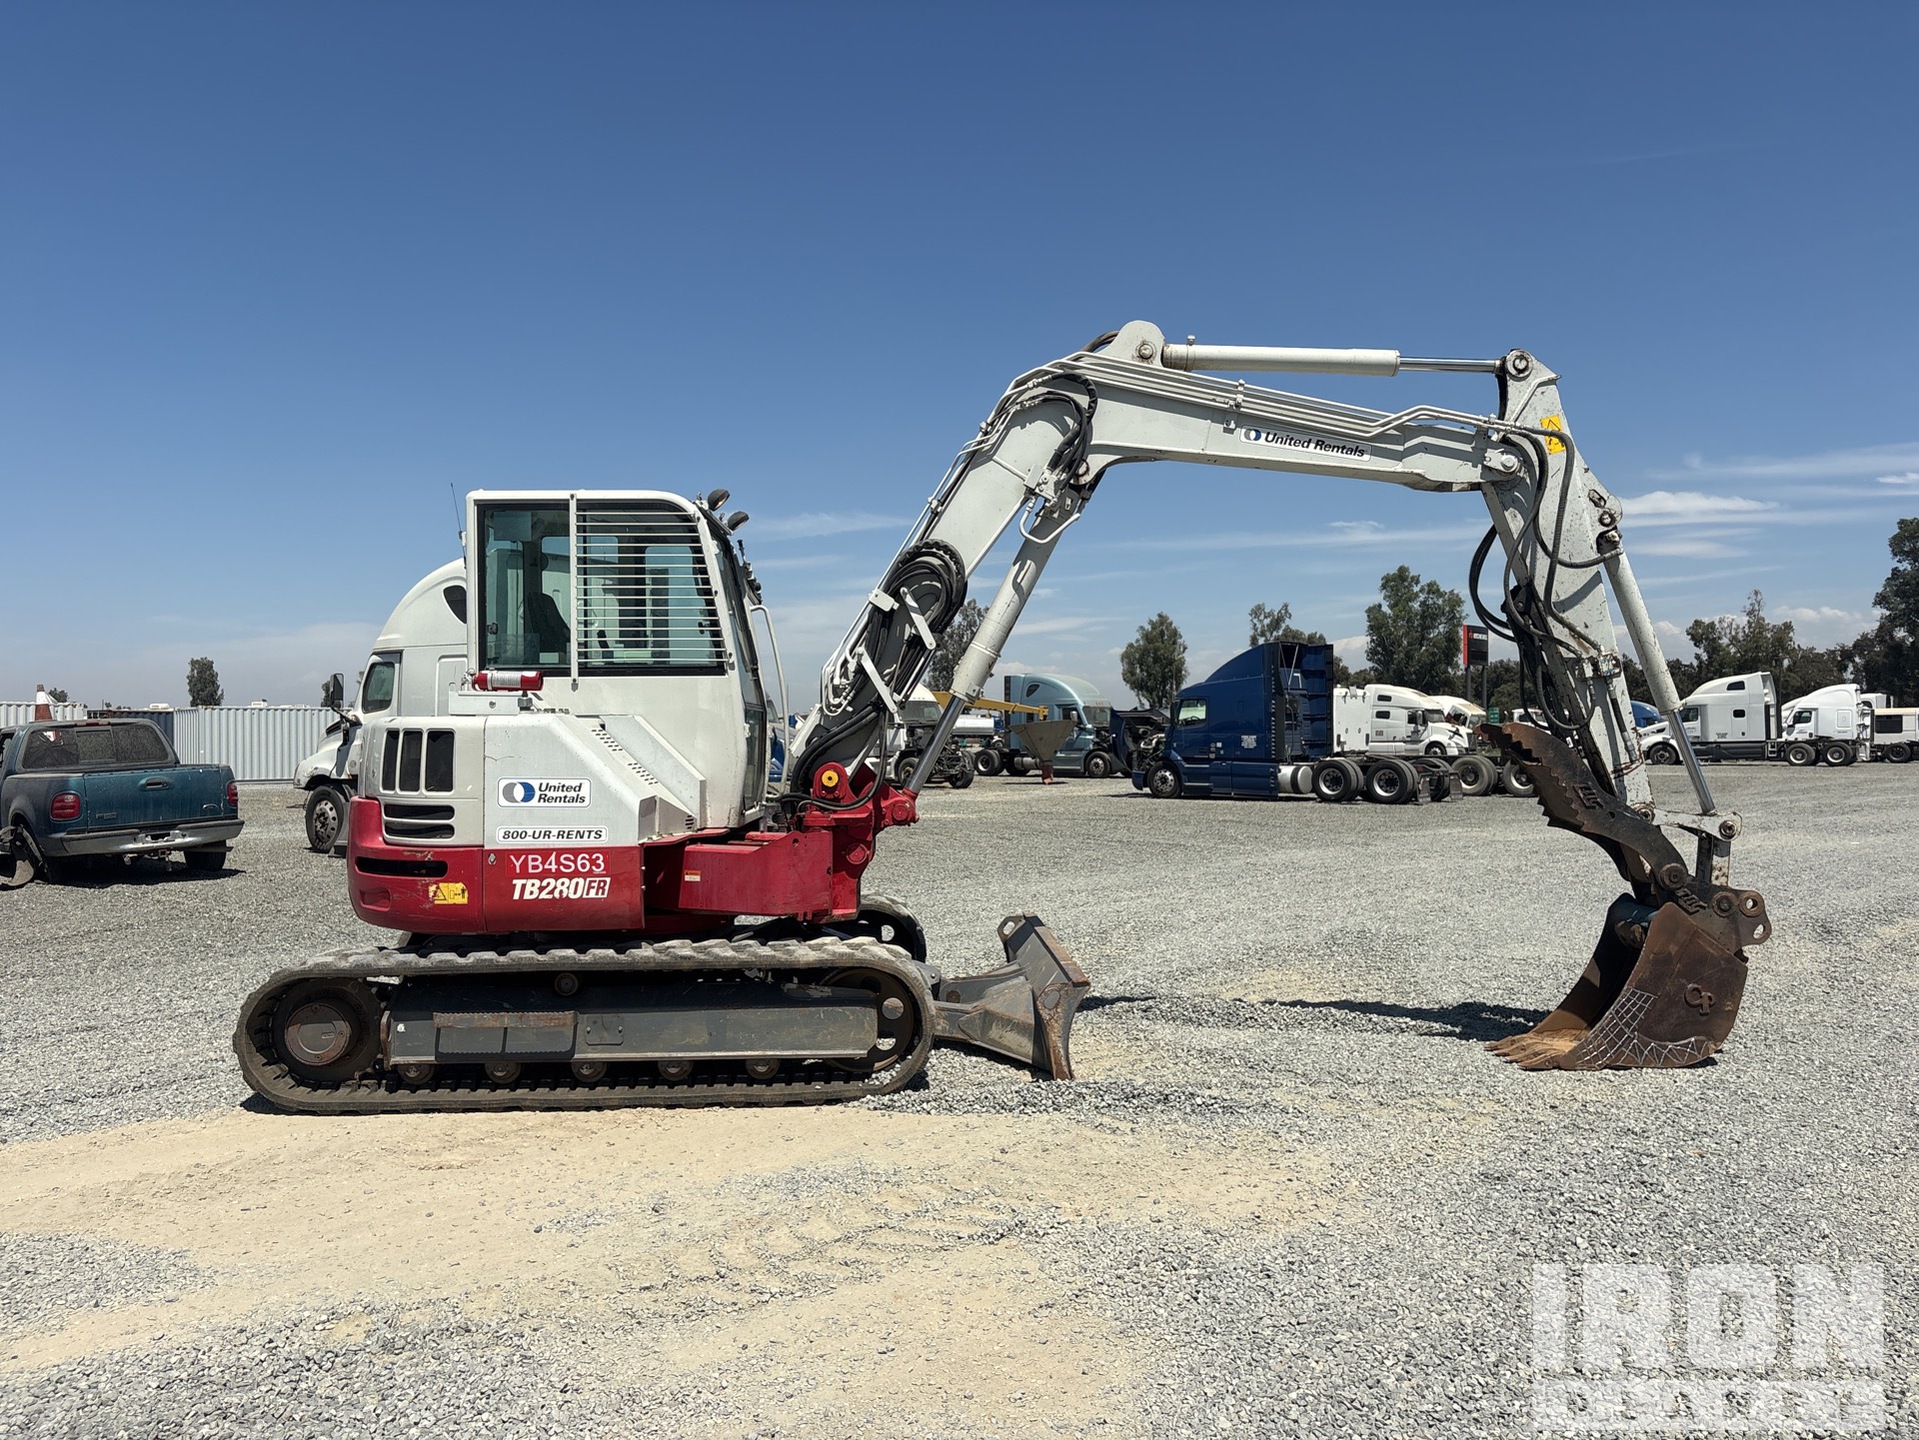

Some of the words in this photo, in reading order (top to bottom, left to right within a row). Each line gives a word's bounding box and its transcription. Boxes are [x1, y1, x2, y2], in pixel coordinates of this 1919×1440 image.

[1265, 431, 1312, 449] United
[1313, 439, 1365, 457] Rentals
[538, 782, 582, 792] United
[537, 793, 585, 803] Rentals
[502, 829, 603, 840] 800-UR-RENTS
[509, 851, 604, 873] YB4S63
